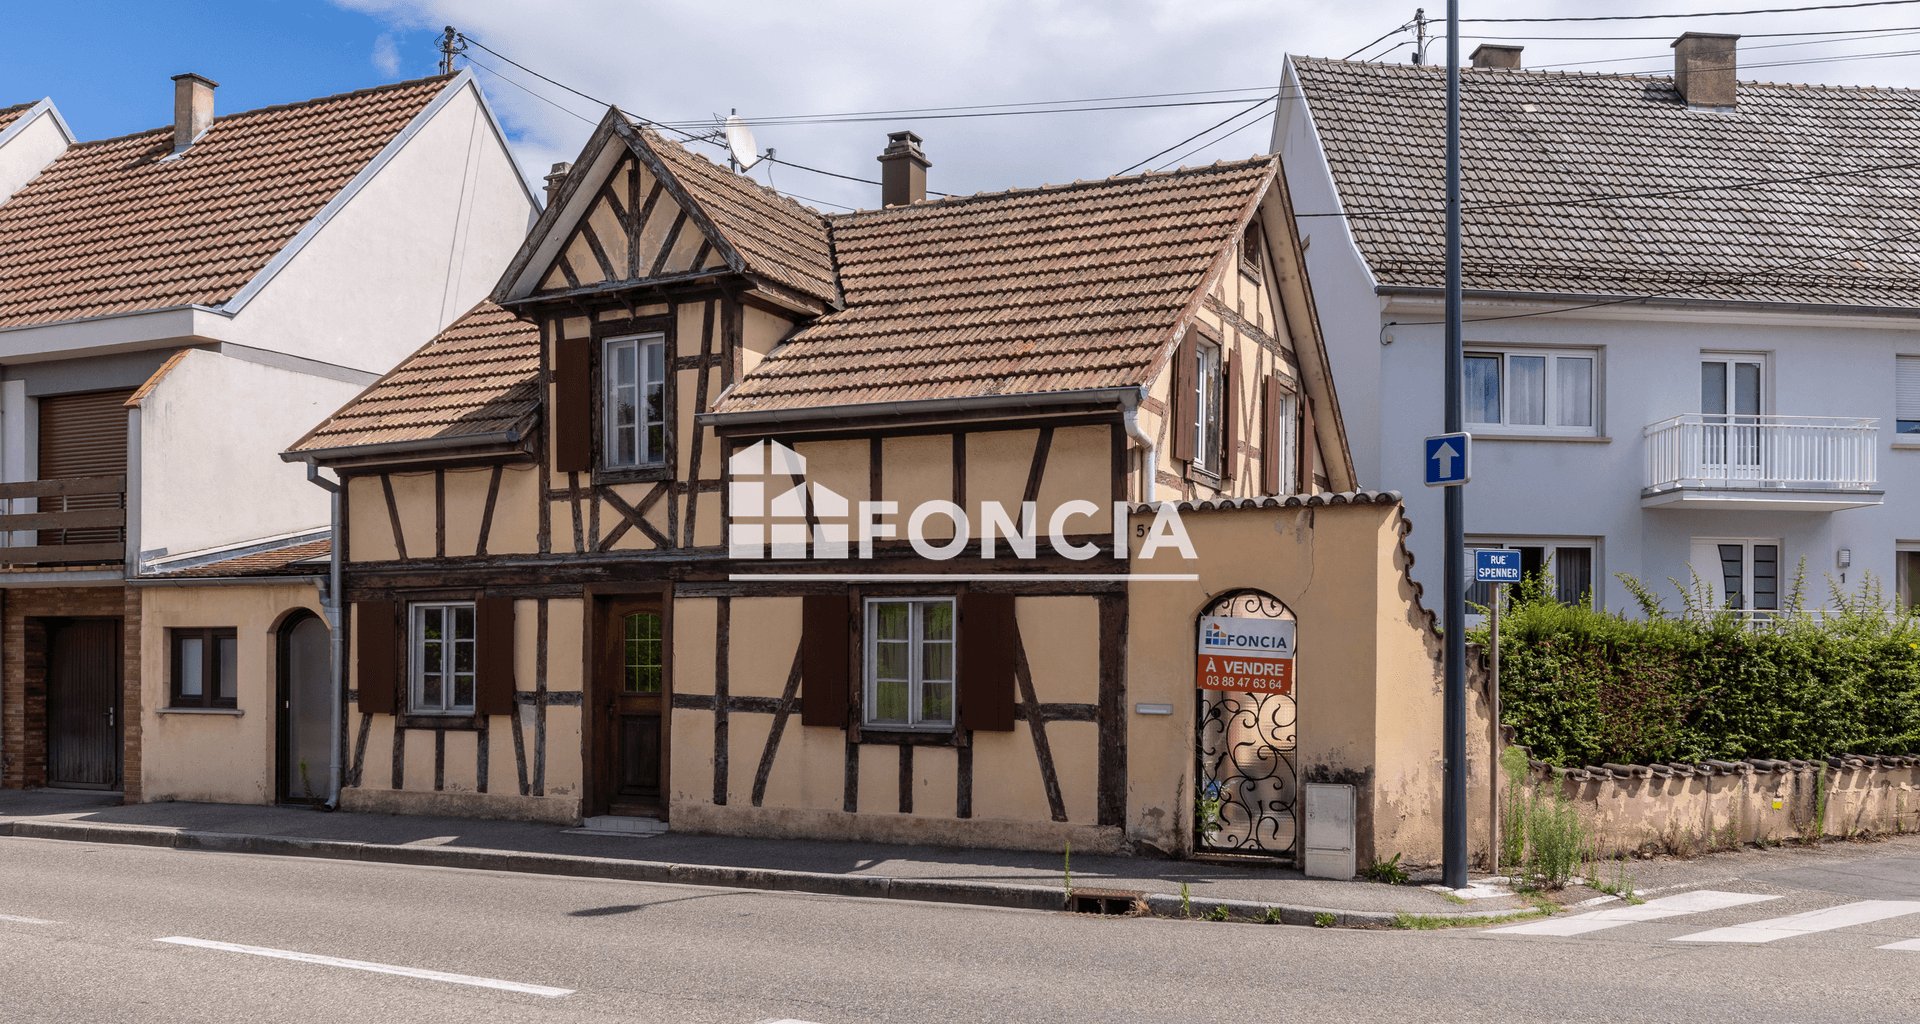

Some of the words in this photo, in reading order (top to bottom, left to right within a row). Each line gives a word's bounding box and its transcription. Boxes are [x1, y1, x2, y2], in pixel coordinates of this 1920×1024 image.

[1490, 555, 1506, 565] RUE
[1478, 567, 1518, 578] SPENNER
[1227, 634, 1287, 649] FONCIA
[1205, 657, 1217, 673] À
[1223, 660, 1284, 677] VENDRE
[1206, 675, 1219, 686] 03
[1222, 676, 1235, 687] 88
[1237, 677, 1251, 688] 47
[1253, 678, 1266, 689] 63
[1269, 679, 1282, 690] 64
